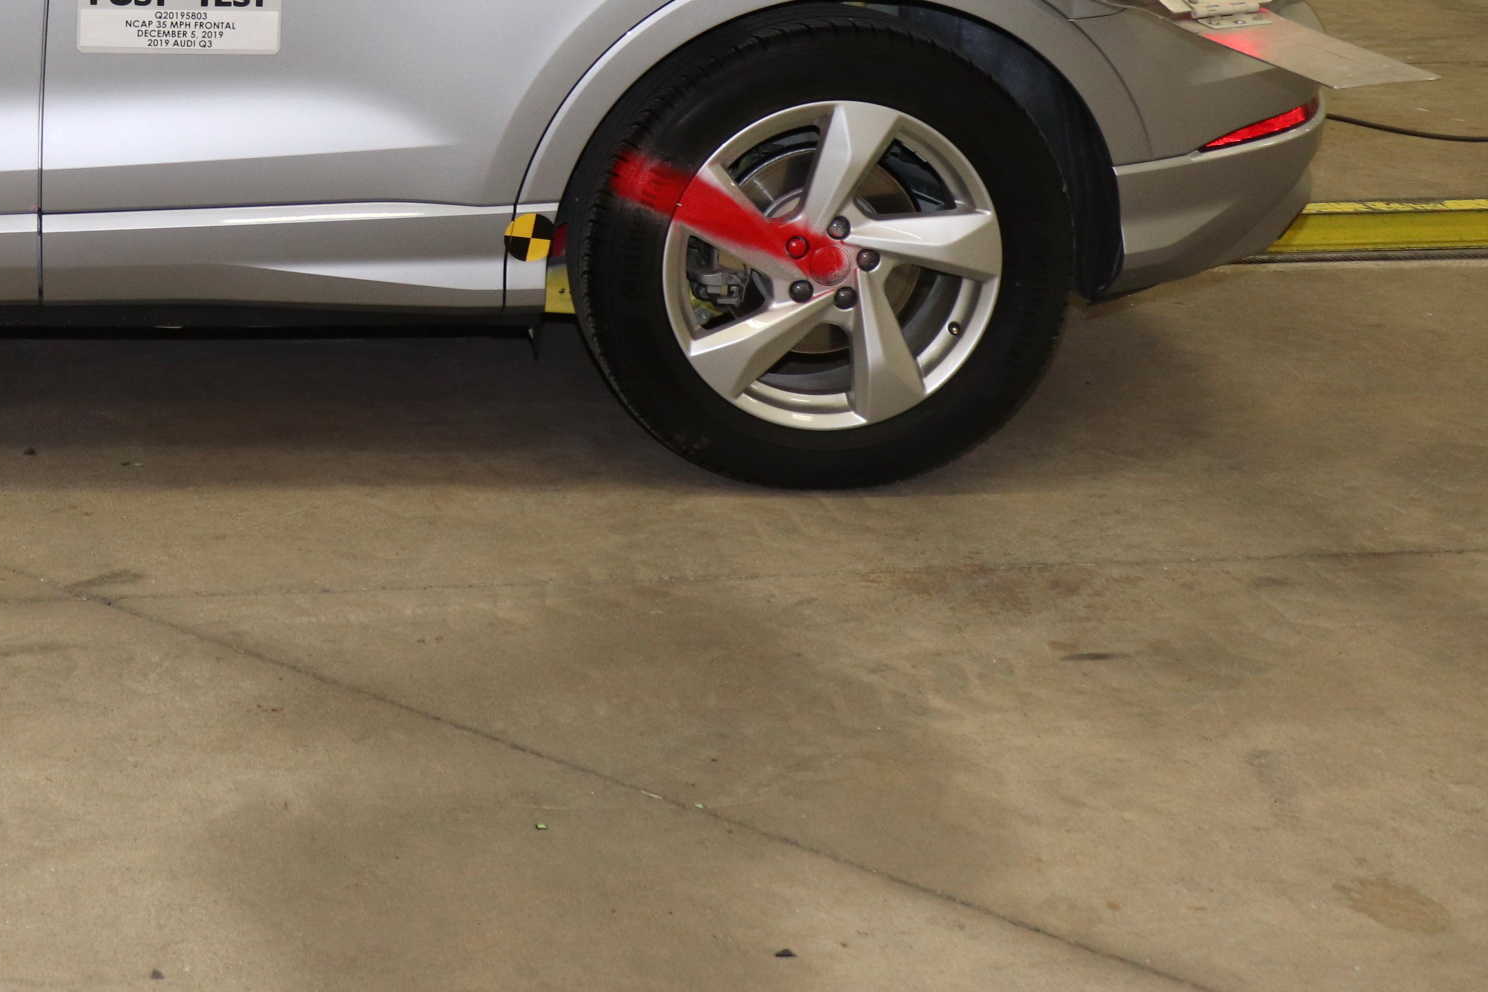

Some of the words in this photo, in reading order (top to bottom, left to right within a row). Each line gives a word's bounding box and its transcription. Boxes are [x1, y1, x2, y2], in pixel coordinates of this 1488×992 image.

[154, 11, 208, 20] Q20195803
[125, 20, 154, 28] NCAP
[155, 20, 168, 29] 35
[169, 20, 192, 29] MPH
[194, 21, 236, 30] FRONTAL
[136, 29, 188, 39] DECEMBER
[190, 30, 199, 40] 5,
[201, 30, 224, 39] 2019
[147, 38, 170, 47] 2019
[172, 39, 196, 48] AUDI
[198, 39, 213, 49] Q3
